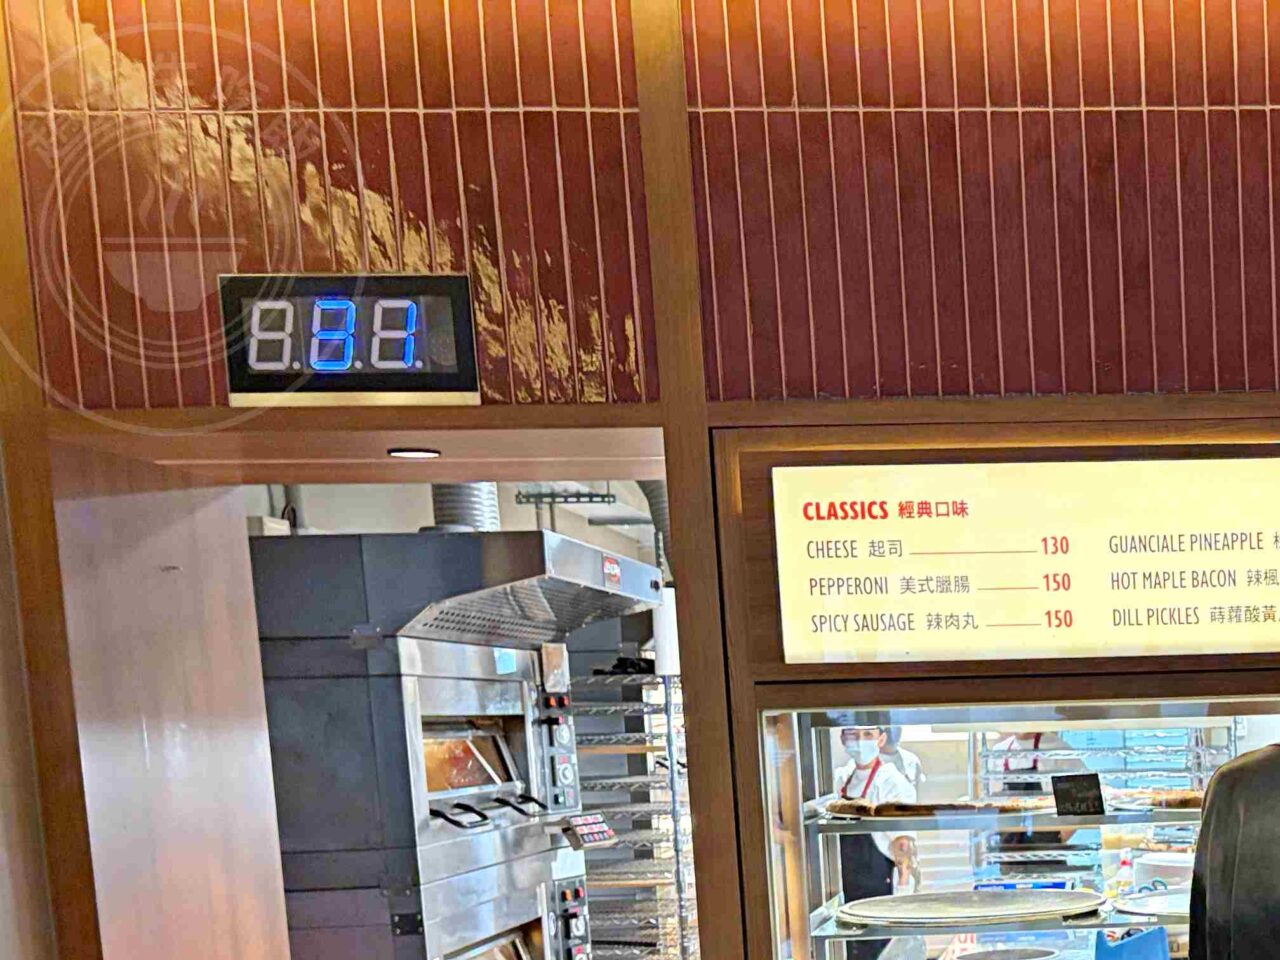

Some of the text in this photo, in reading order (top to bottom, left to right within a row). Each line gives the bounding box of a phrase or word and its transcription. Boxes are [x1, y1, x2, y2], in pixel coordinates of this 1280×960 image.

[802, 500, 970, 522] CLASSICS 經典口味
[806, 535, 1070, 560] CHEESE 起司 130
[1108, 534, 1186, 555] GUANCIALE
[1189, 531, 1264, 553] PINEAPPLE
[809, 573, 1072, 597] PEPPERONI 美式臘腸 150
[1110, 571, 1139, 591] HOT
[1142, 570, 1188, 590] MAPLE
[1191, 568, 1238, 589] BACON
[811, 609, 1074, 634] SPICY SAUSAGE 辣肉丸 150
[1112, 608, 1145, 627] DILL
[1147, 606, 1200, 626] PICKLES
